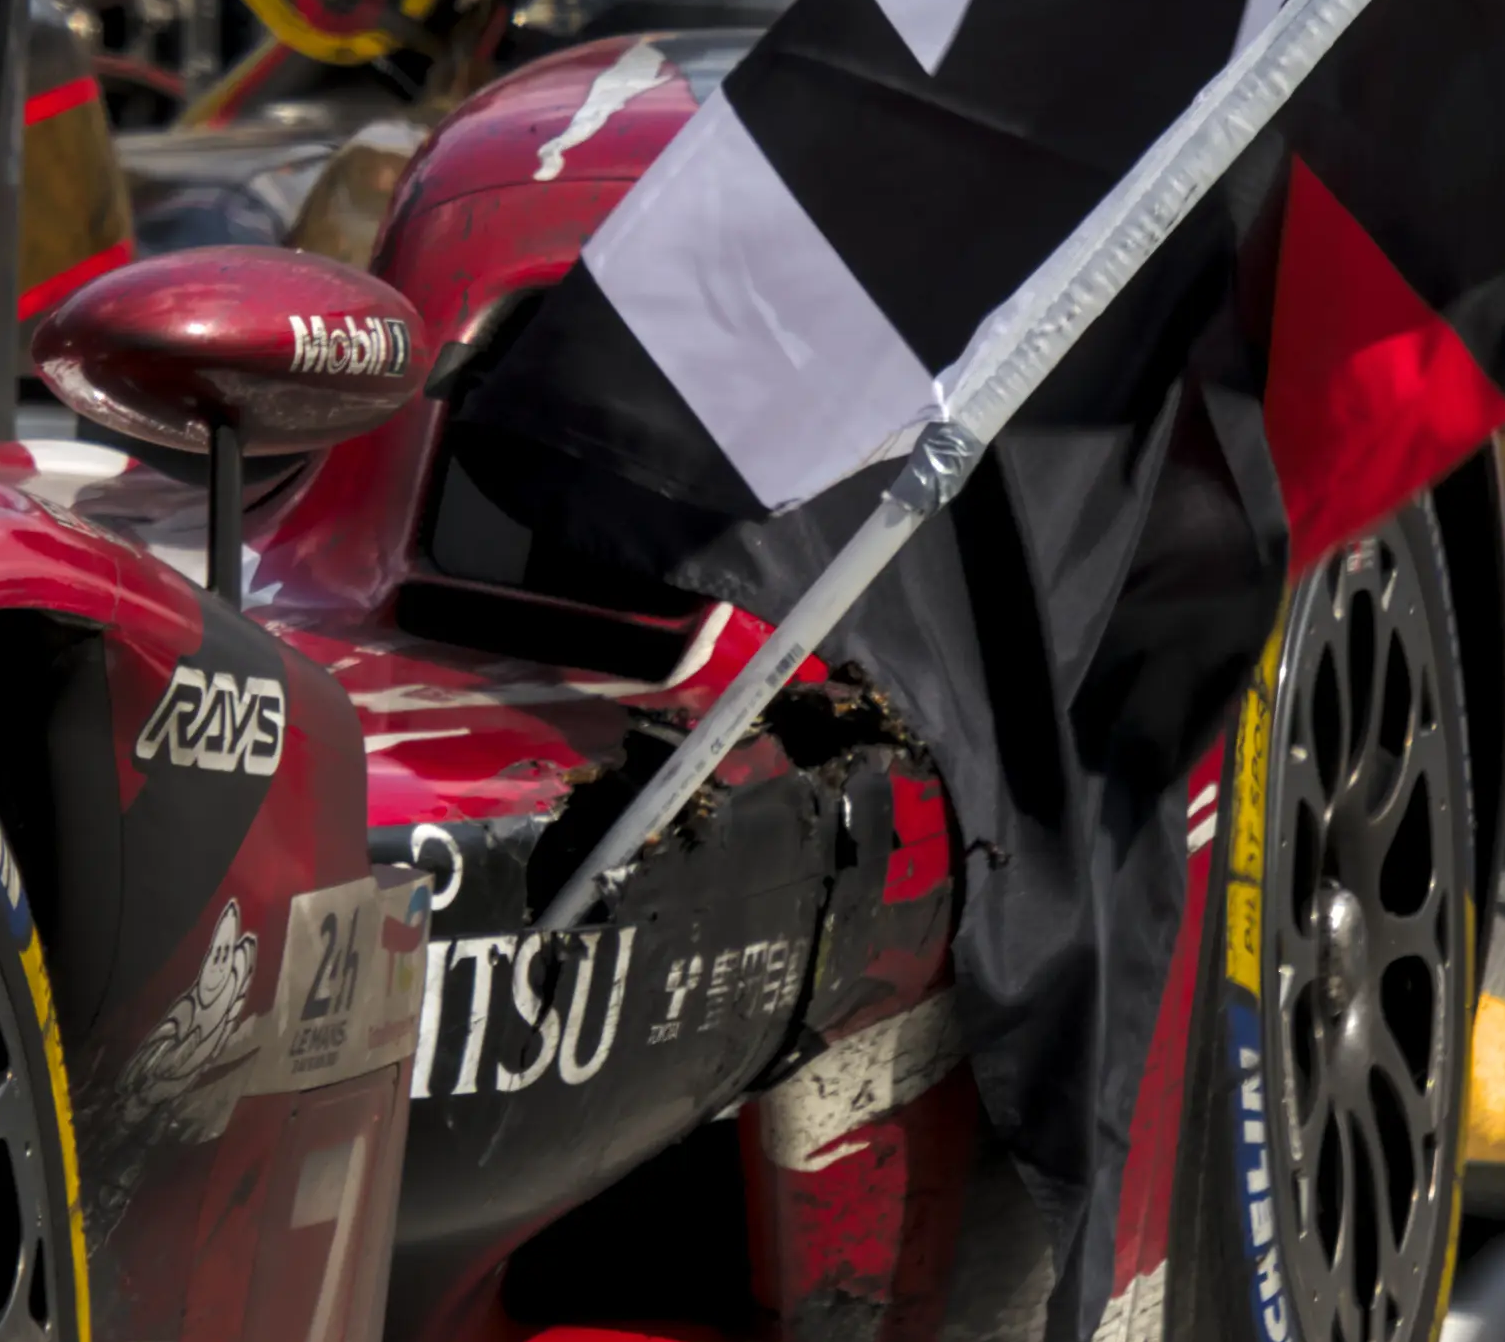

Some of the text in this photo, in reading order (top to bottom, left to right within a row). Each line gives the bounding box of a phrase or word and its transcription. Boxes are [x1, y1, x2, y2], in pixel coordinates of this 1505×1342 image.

[288, 314, 386, 375] Mobil
[134, 665, 286, 777] RAYS
[411, 926, 637, 1099] ITSU
